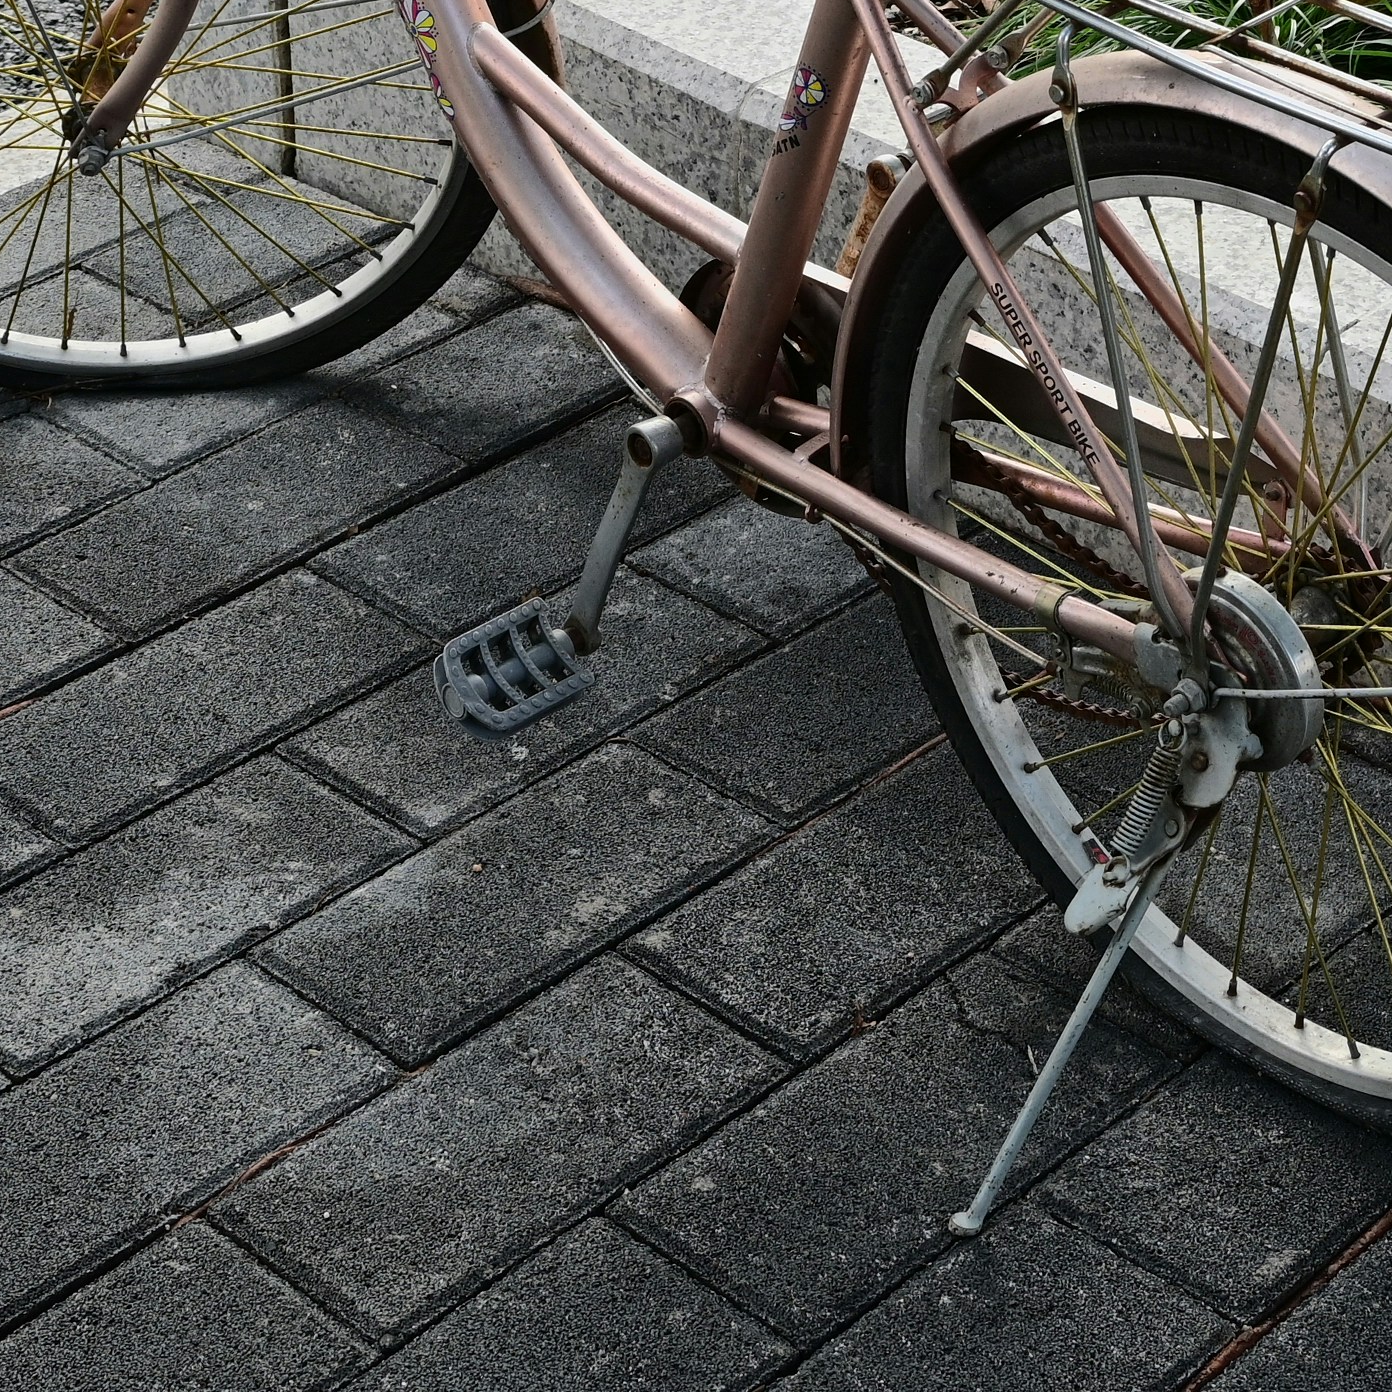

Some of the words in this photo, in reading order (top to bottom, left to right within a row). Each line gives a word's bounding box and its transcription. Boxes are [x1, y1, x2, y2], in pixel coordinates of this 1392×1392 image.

[991, 282, 1032, 349] SUPER
[1029, 350, 1073, 416] SPORT
[1067, 419, 1100, 468] BIKE
